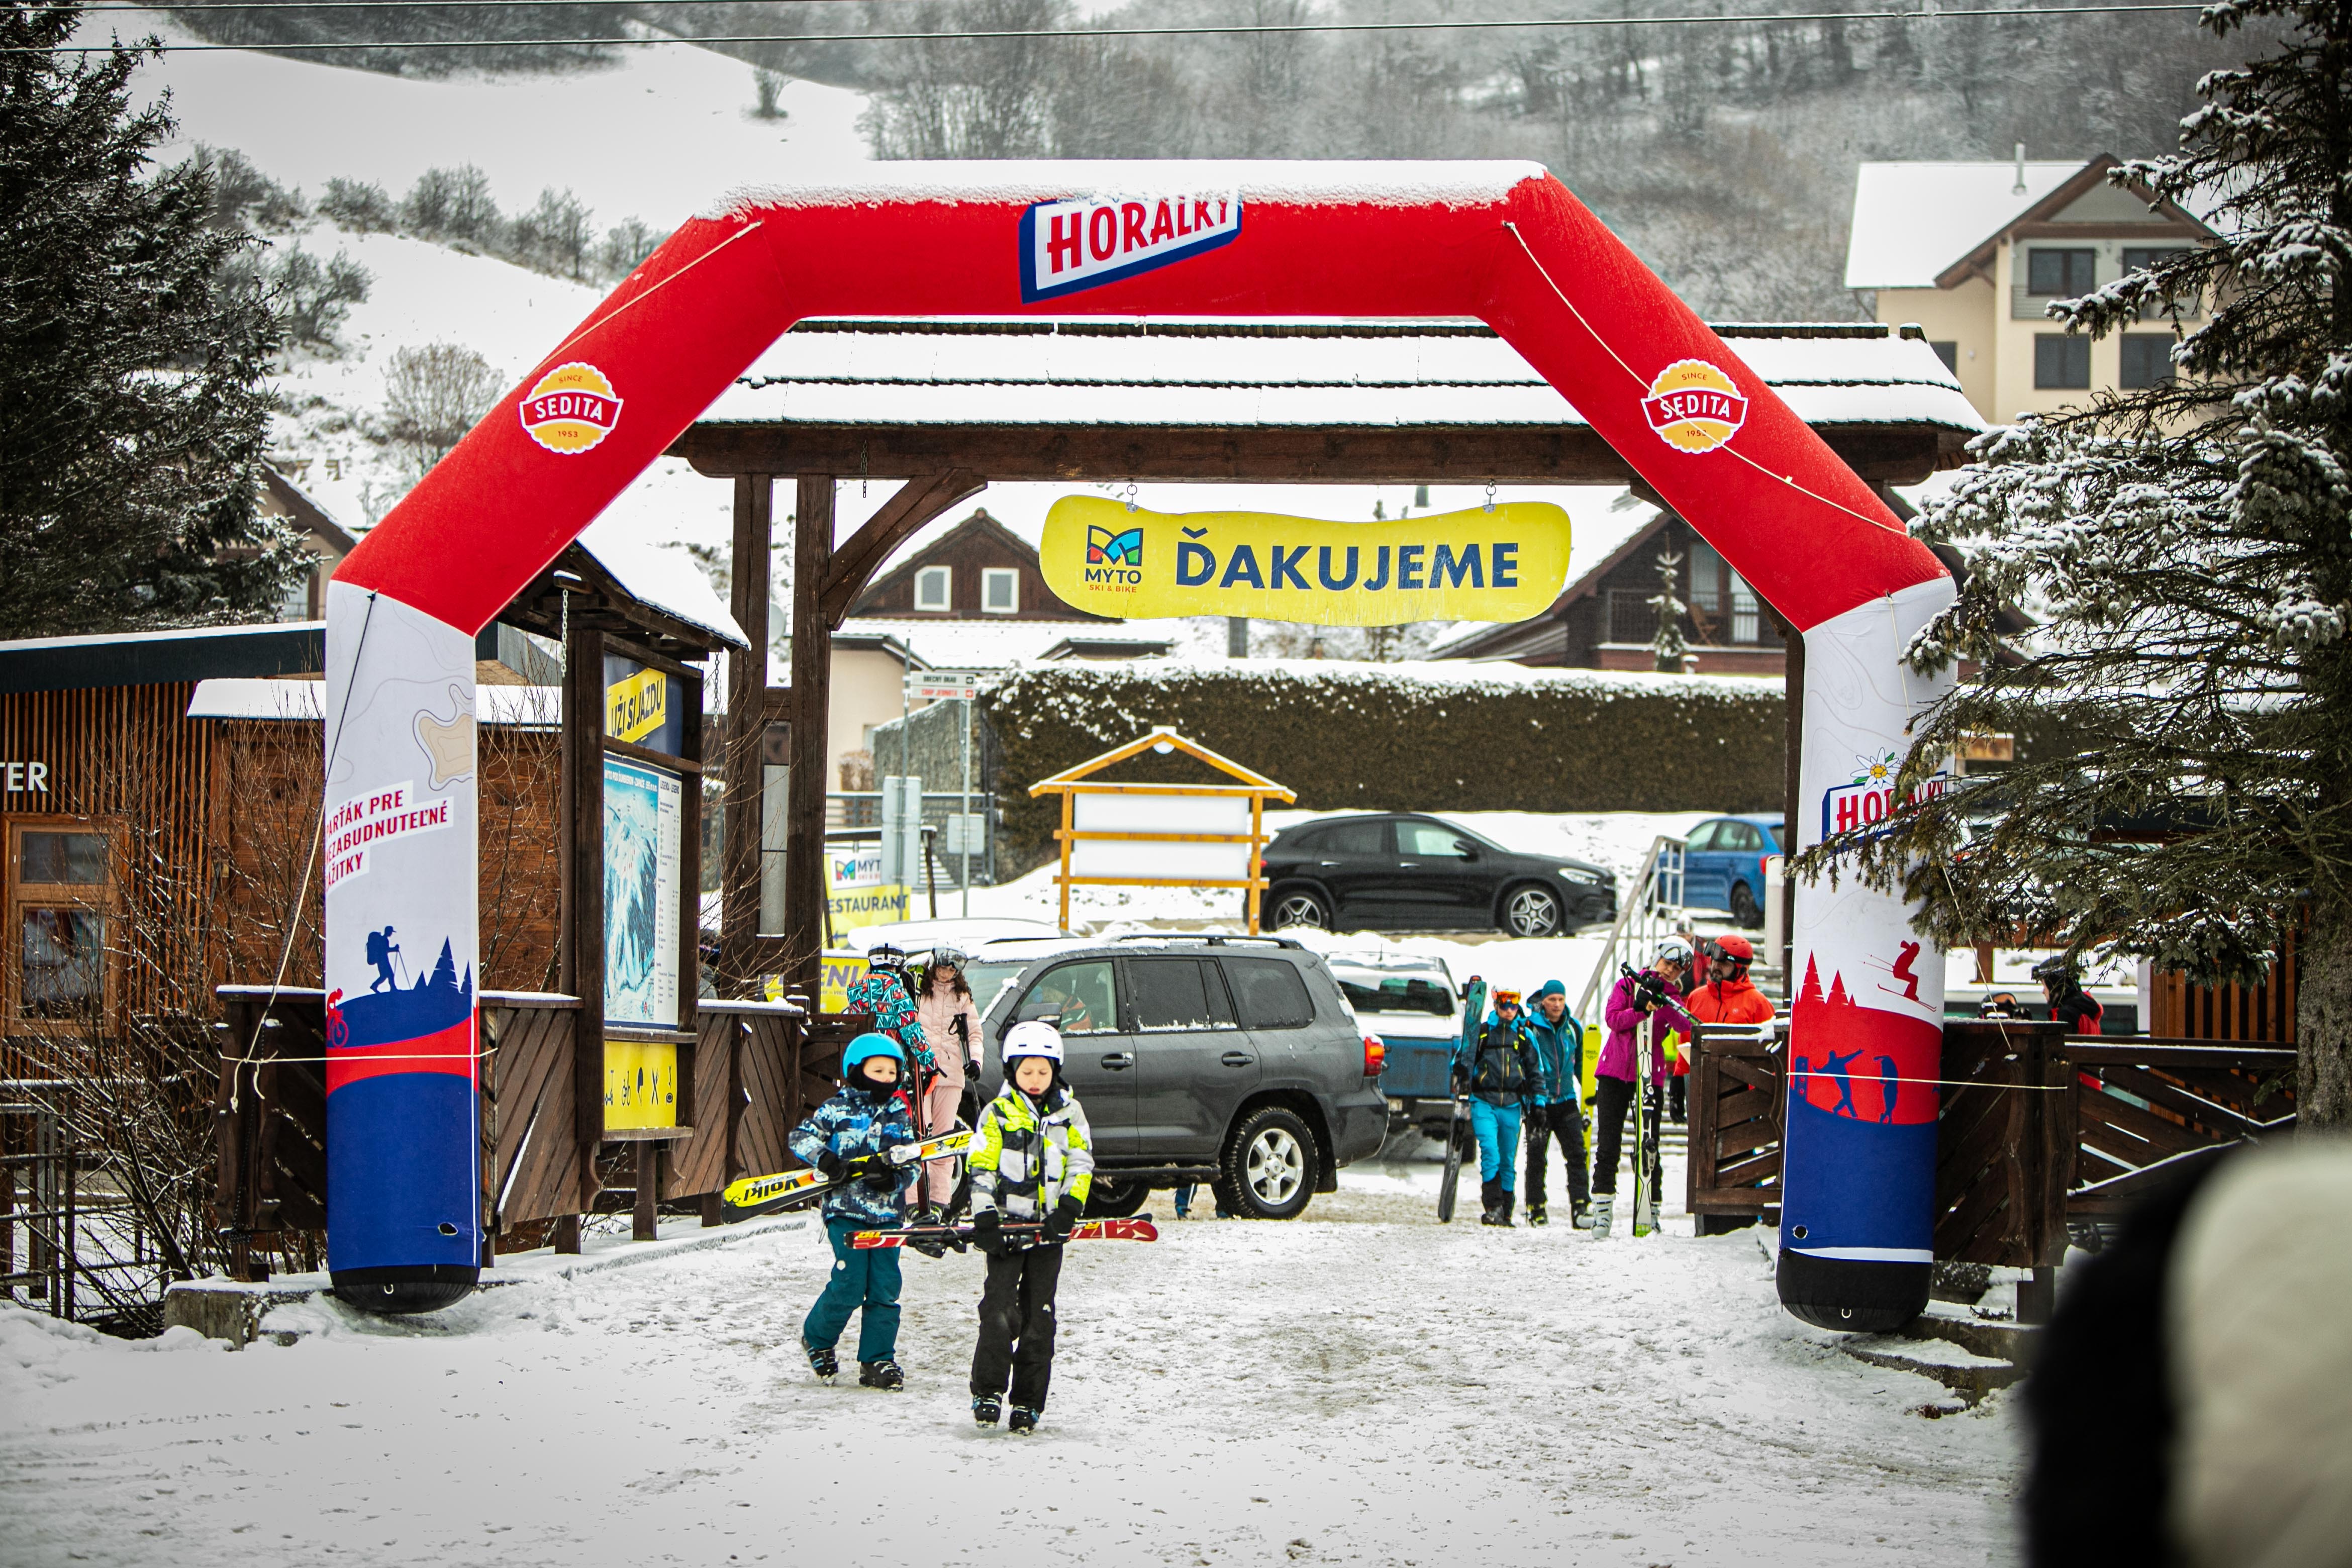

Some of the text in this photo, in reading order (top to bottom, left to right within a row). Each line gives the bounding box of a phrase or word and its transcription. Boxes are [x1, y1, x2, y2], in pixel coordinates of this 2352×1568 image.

[1047, 195, 1230, 274] HORALKY
[559, 375, 583, 383] SINCE
[1682, 372, 1707, 380] SINCE
[535, 396, 602, 421] SEDITA
[1660, 395, 1730, 419] SEDITA
[1176, 526, 1519, 591] ĎAKUJEME
[1085, 567, 1142, 584] MÝTO
[612, 678, 663, 737] UŽI SI JAZDU
[369, 790, 404, 815] PRE
[857, 858, 881, 872] MÝT
[828, 894, 909, 914] ESTAURANT
